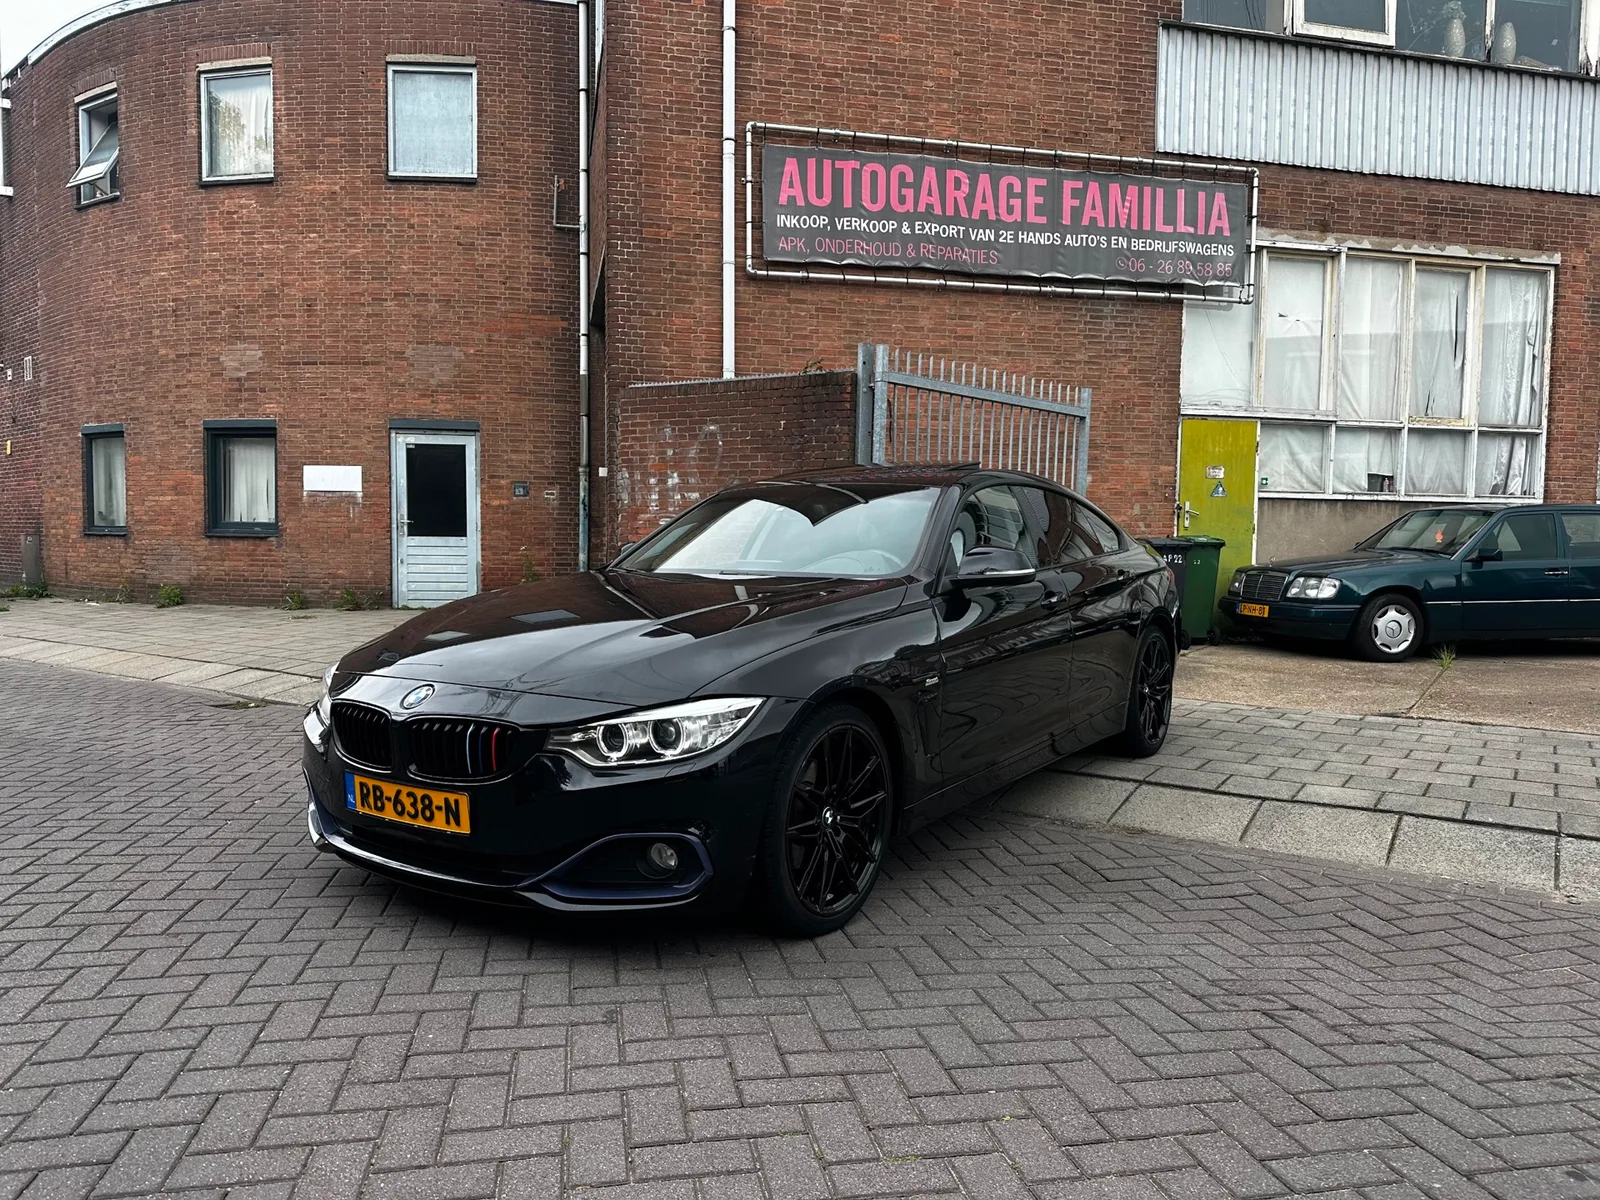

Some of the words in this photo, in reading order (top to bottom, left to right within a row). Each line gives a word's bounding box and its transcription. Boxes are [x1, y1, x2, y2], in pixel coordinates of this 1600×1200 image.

[779, 157, 1047, 224] AUTOGARAGE
[1062, 179, 1230, 236] FAMILLIA
[777, 214, 831, 231] INKOOP,
[835, 217, 897, 233] VERKOOP
[901, 221, 911, 234] &
[915, 221, 965, 239] EXPORT
[969, 228, 995, 241] VAN
[999, 230, 1014, 243] 2E
[1018, 230, 1061, 245] HANDS
[1064, 234, 1107, 248] AUTO'S
[1111, 236, 1127, 249] EN
[1131, 238, 1234, 256] BEDRIJFSWAGENS
[779, 236, 810, 254] APK,
[815, 237, 901, 257] ONDERHOUD
[906, 243, 916, 258] &
[920, 243, 998, 264] REPARATIES
[1129, 257, 1146, 272] 06
[1157, 259, 1173, 274] 26
[1177, 260, 1192, 274] 89
[1197, 262, 1212, 277] 58
[1216, 262, 1232, 277] 85
[359, 781, 461, 827] RB-638-N
